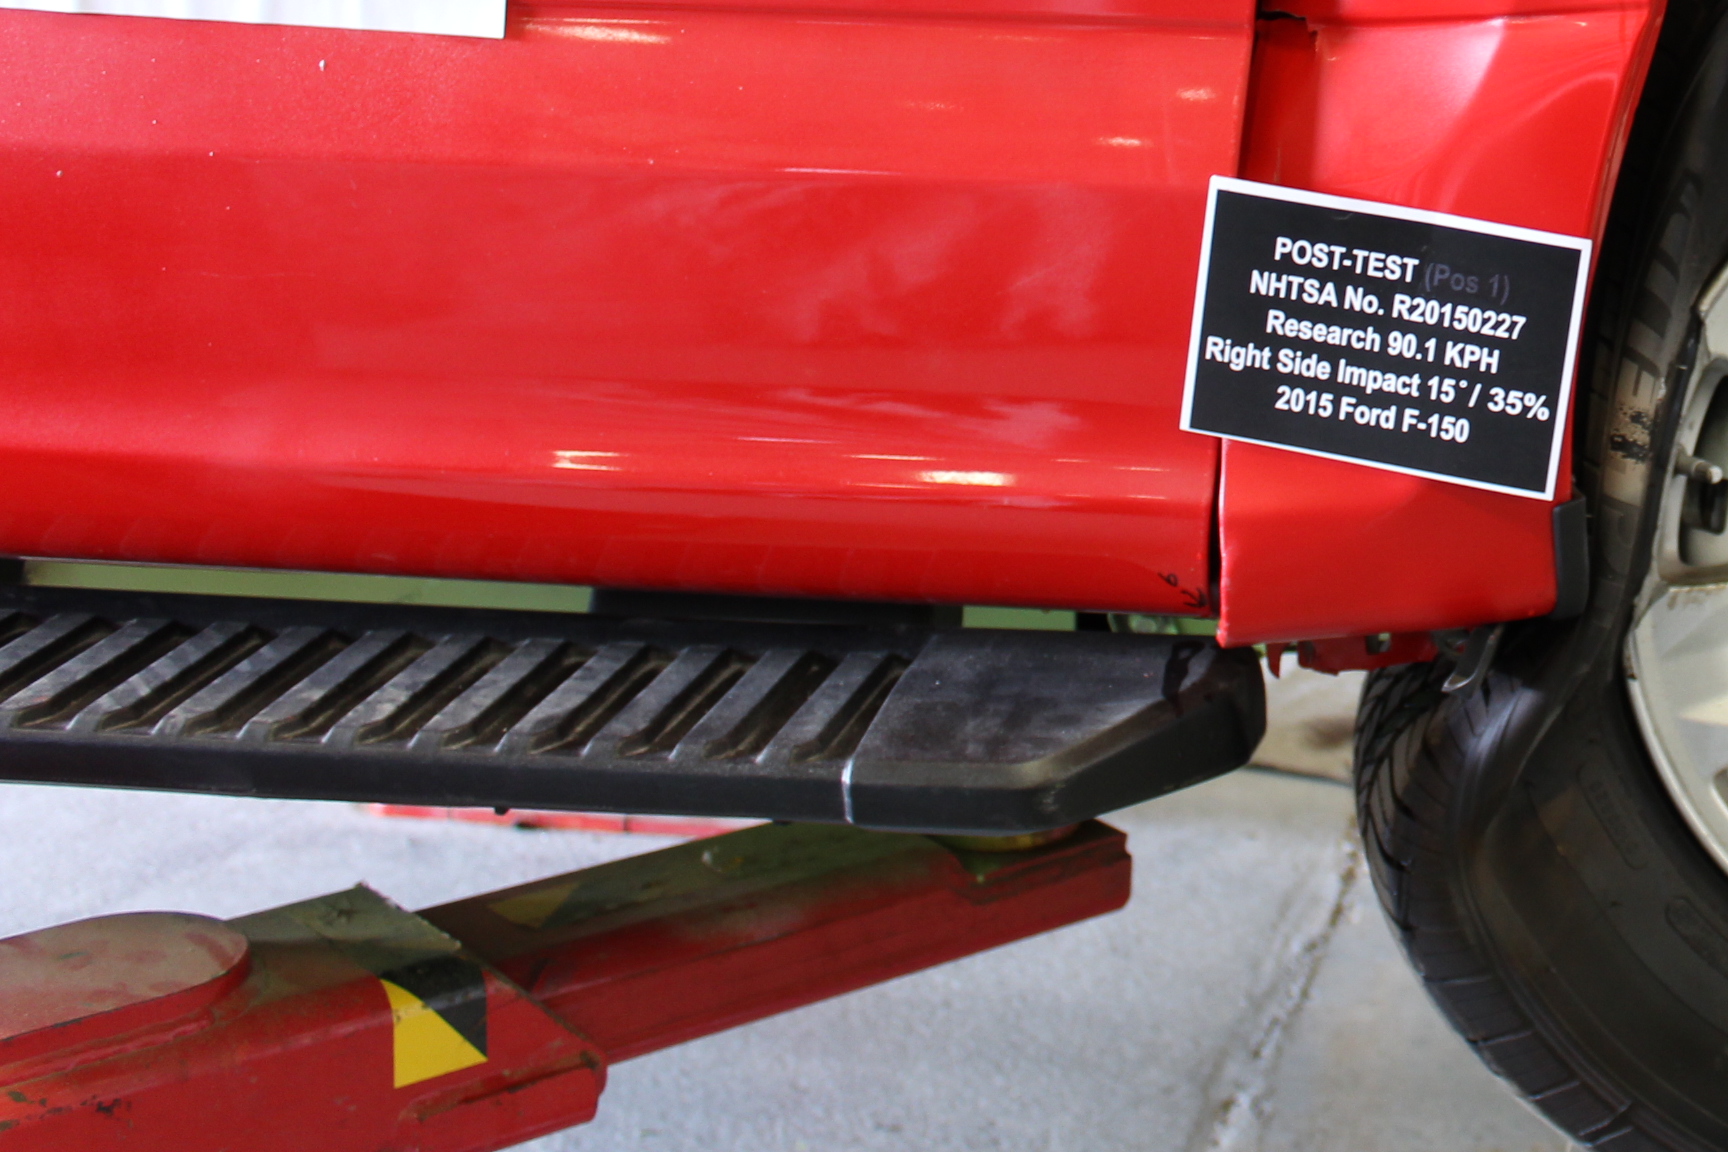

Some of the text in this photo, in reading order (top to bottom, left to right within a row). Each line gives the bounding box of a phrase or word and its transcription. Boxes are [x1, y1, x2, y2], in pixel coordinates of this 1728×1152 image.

[1275, 237, 1419, 282] POST-TEST
[1250, 270, 1526, 339] NHTSA No. R20150227
[1266, 309, 1499, 373] Research 90.1 KPH
[1205, 336, 1271, 370] Right
[1277, 348, 1331, 380] Side
[1337, 359, 1421, 397] Impact
[1487, 387, 1549, 420] 35%
[1275, 385, 1469, 443] 2015 Ford F-150
